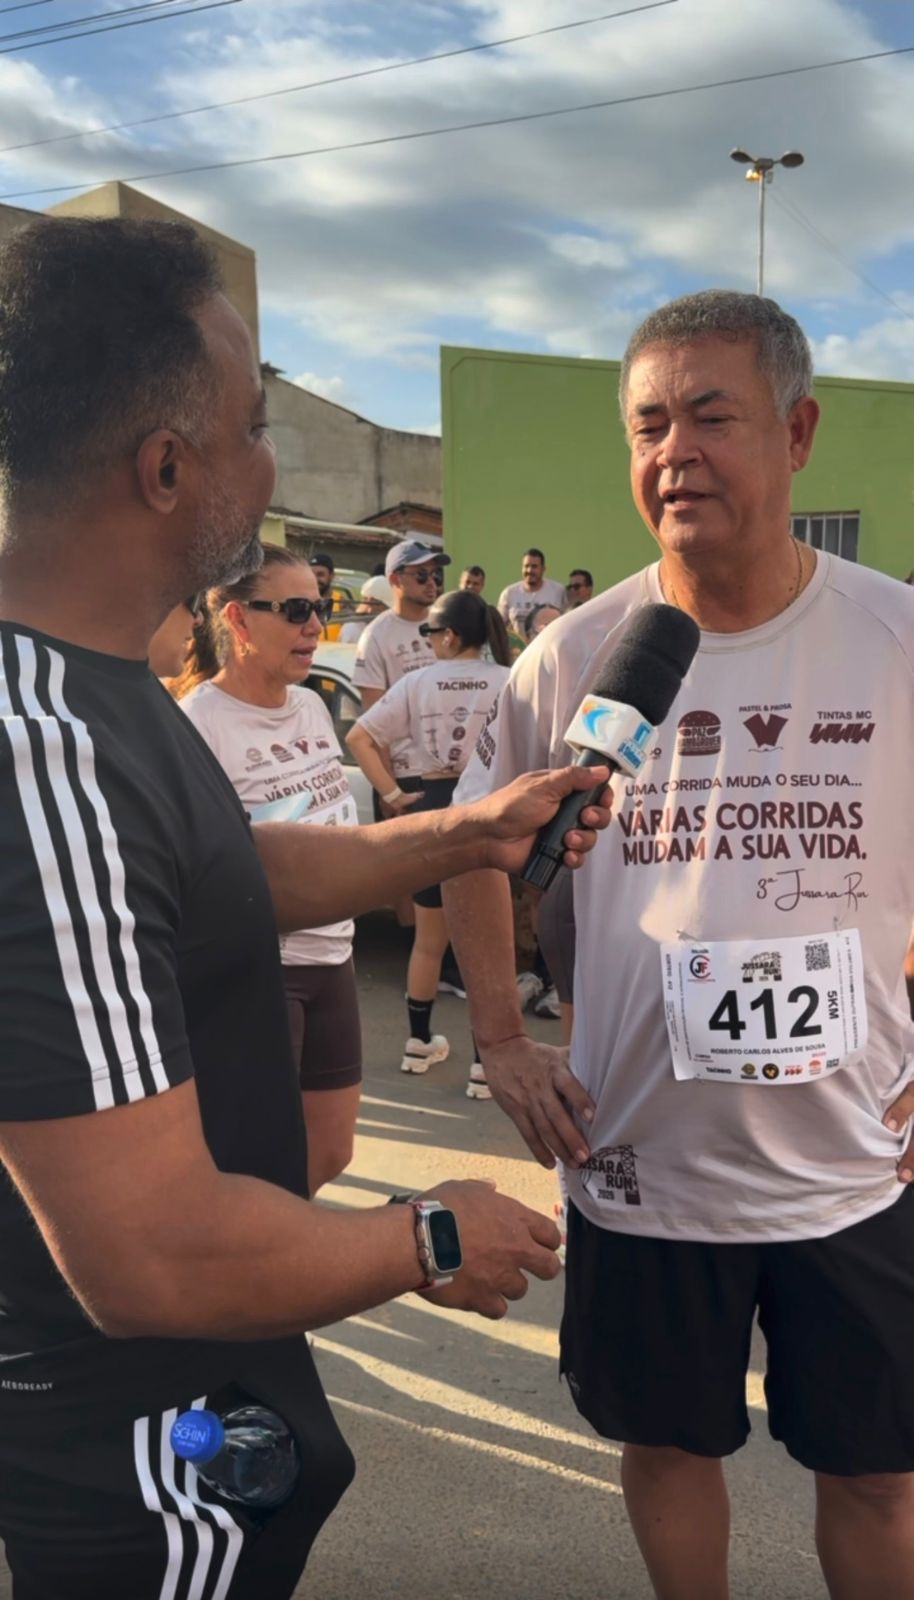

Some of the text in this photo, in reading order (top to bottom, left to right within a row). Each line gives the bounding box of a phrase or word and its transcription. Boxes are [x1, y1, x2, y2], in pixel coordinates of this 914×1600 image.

[436, 681, 488, 691] TACINHO
[817, 711, 872, 720] TINTAS MC
[625, 773, 862, 797] UMA CORRIDA MUDA O SEU DIA...
[617, 799, 863, 837] VÁRIAS CORRIDAS
[622, 833, 867, 866] MUDAM A SUA VIDA.
[774, 868, 843, 911] Jussara
[843, 872, 868, 912] Run
[708, 985, 822, 1040] 412
[827, 990, 840, 1020] 5KM
[805, 1043, 826, 1052] SOUSA
[606, 1174, 633, 1190] RUN
[1, 1380, 53, 1390] AEROREADY
